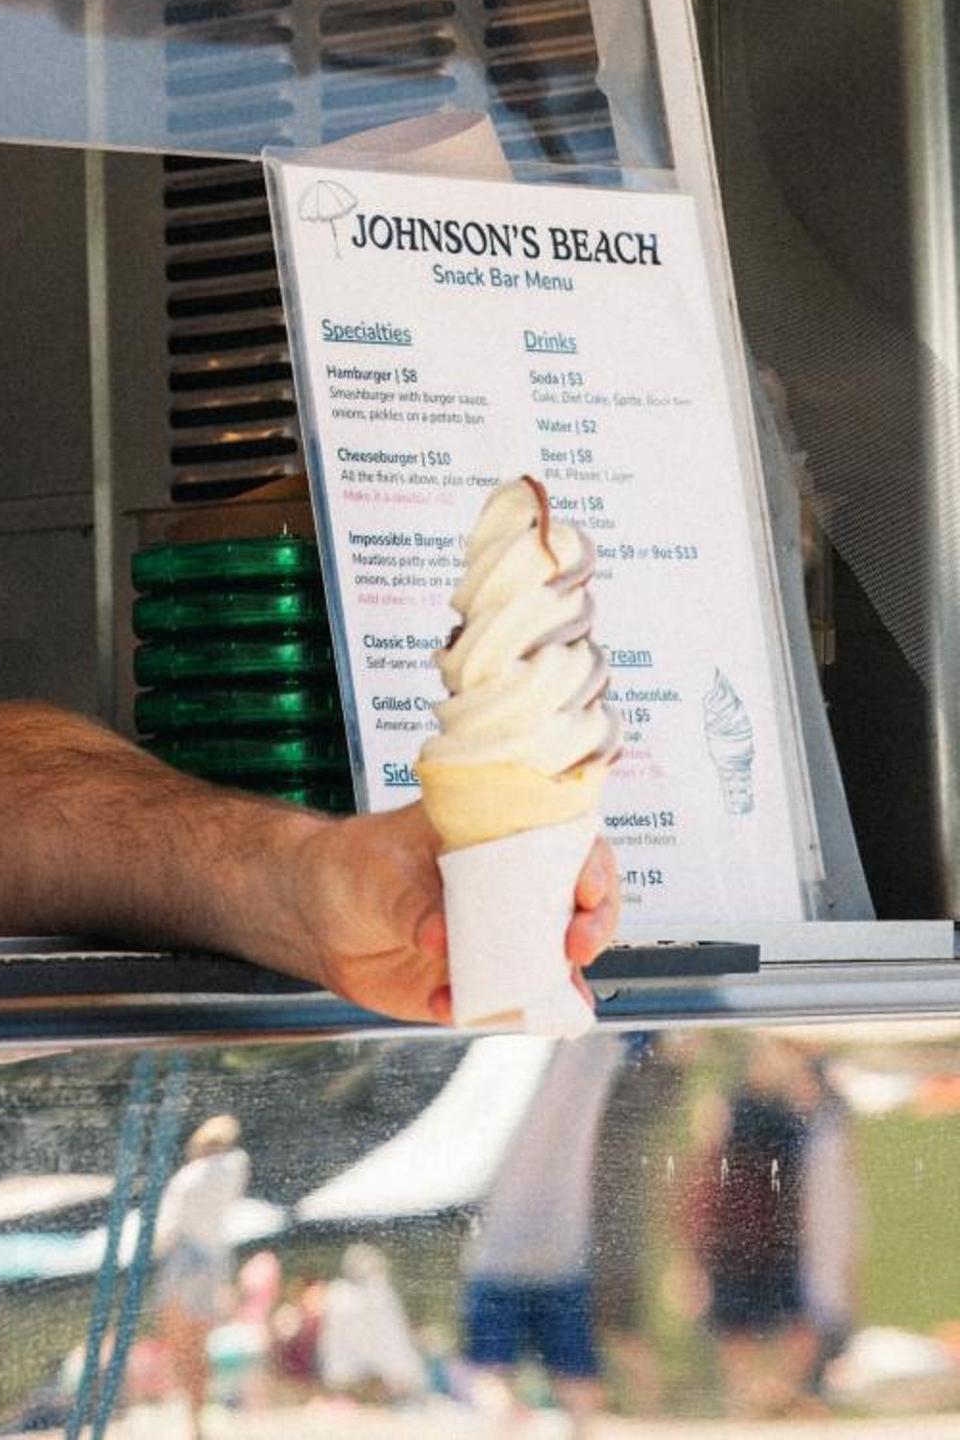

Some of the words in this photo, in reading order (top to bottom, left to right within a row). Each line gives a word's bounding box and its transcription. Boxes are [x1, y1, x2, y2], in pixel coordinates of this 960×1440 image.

[351, 214, 541, 259] JOHNSON'S
[549, 227, 662, 265] BEACH
[433, 264, 484, 287] Snack
[490, 268, 519, 289] Bar
[526, 271, 574, 291] Menu
[322, 318, 412, 345] Specialties
[524, 329, 577, 351] Drinks
[326, 365, 392, 384] Hamburger
[402, 367, 418, 383] $8
[529, 370, 559, 385] Soda
[330, 386, 395, 404] Smashburger
[398, 390, 421, 403] with
[423, 391, 457, 406] burger
[370, 407, 405, 422] pickles
[406, 411, 419, 423] on
[429, 412, 463, 425] potato
[464, 413, 485, 426] bun
[536, 418, 571, 433] Water
[582, 419, 597, 434] $2
[337, 448, 418, 467] Cheeseburger
[427, 450, 451, 466] $10
[541, 448, 567, 462] Beer
[577, 449, 592, 464] $8
[358, 470, 374, 482] the
[548, 496, 579, 510] Cider
[588, 496, 604, 511] $8
[349, 531, 412, 548] Impossible
[414, 533, 454, 550] Burger
[352, 552, 398, 566] Meatless
[399, 555, 426, 568] patty
[428, 556, 451, 567] with
[619, 544, 635, 559] $9
[675, 545, 698, 561] $13
[392, 574, 427, 588] pickles
[430, 577, 442, 587] on
[363, 634, 403, 649] Classic
[406, 635, 443, 650] Beach
[372, 696, 412, 711] Grilled
[634, 707, 650, 723] $5
[375, 718, 424, 731] American
[659, 811, 674, 827] $2
[648, 869, 664, 884] $2
